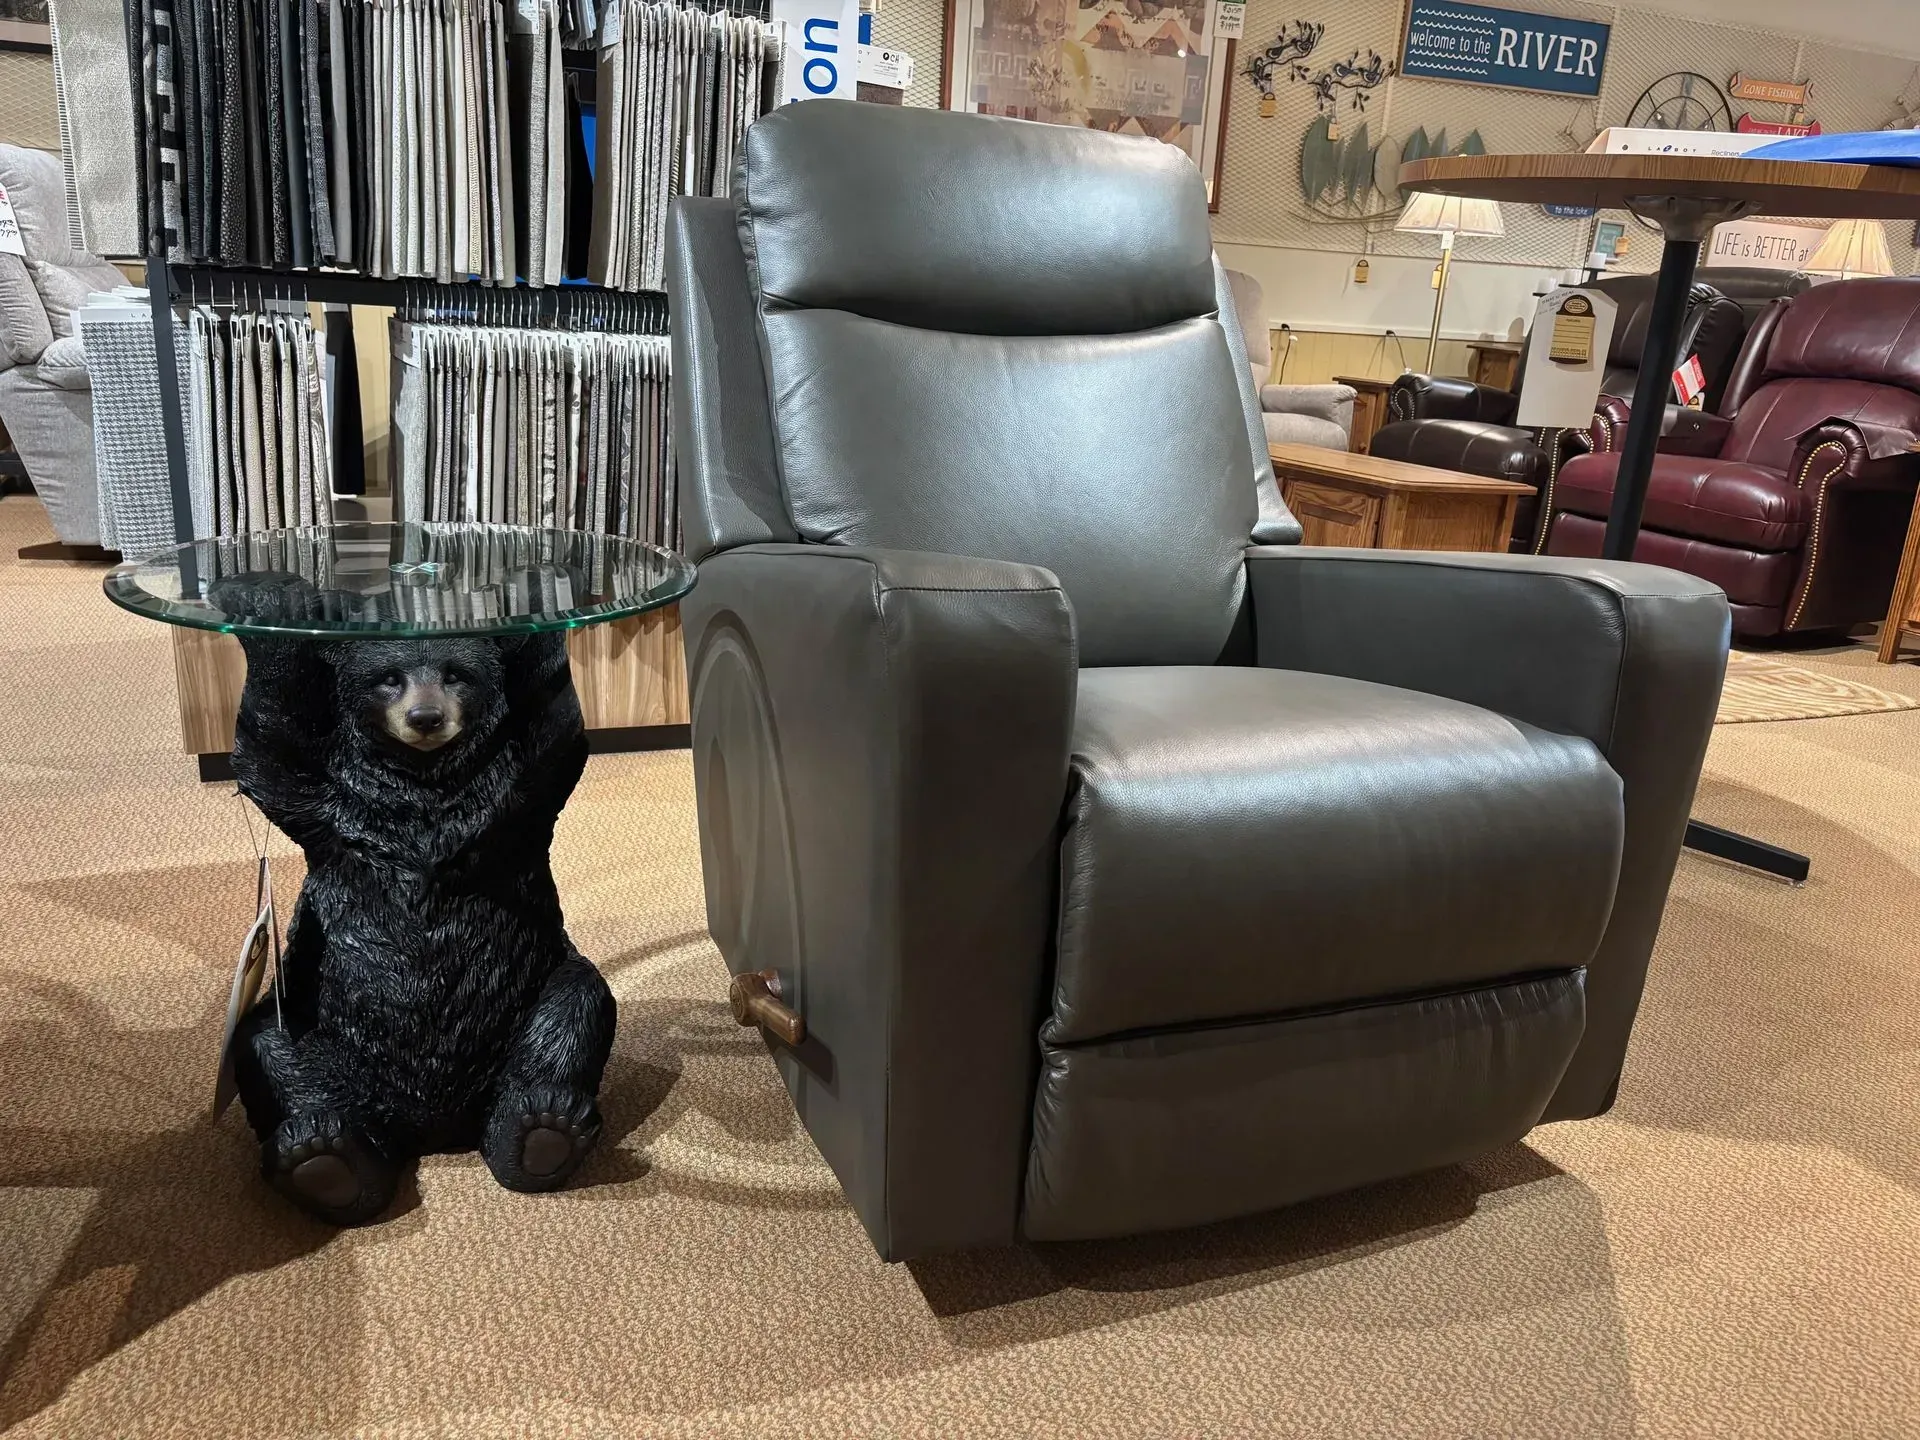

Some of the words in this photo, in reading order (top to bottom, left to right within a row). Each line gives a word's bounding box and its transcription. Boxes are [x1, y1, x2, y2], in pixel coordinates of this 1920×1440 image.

[1410, 29, 1456, 50] welcome
[1459, 37, 1471, 52] to
[1473, 36, 1491, 55] the
[1494, 27, 1599, 77] RIVER
[1743, 84, 1766, 96] GONE
[1767, 87, 1801, 100] FISHING
[1555, 206, 1562, 214] to
[1563, 206, 1574, 215] the
[1575, 206, 1588, 215] lake
[1714, 232, 1742, 256] LIFE
[1741, 240, 1751, 257] is
[1753, 235, 1797, 261] BETTER
[1798, 248, 1809, 262] at
